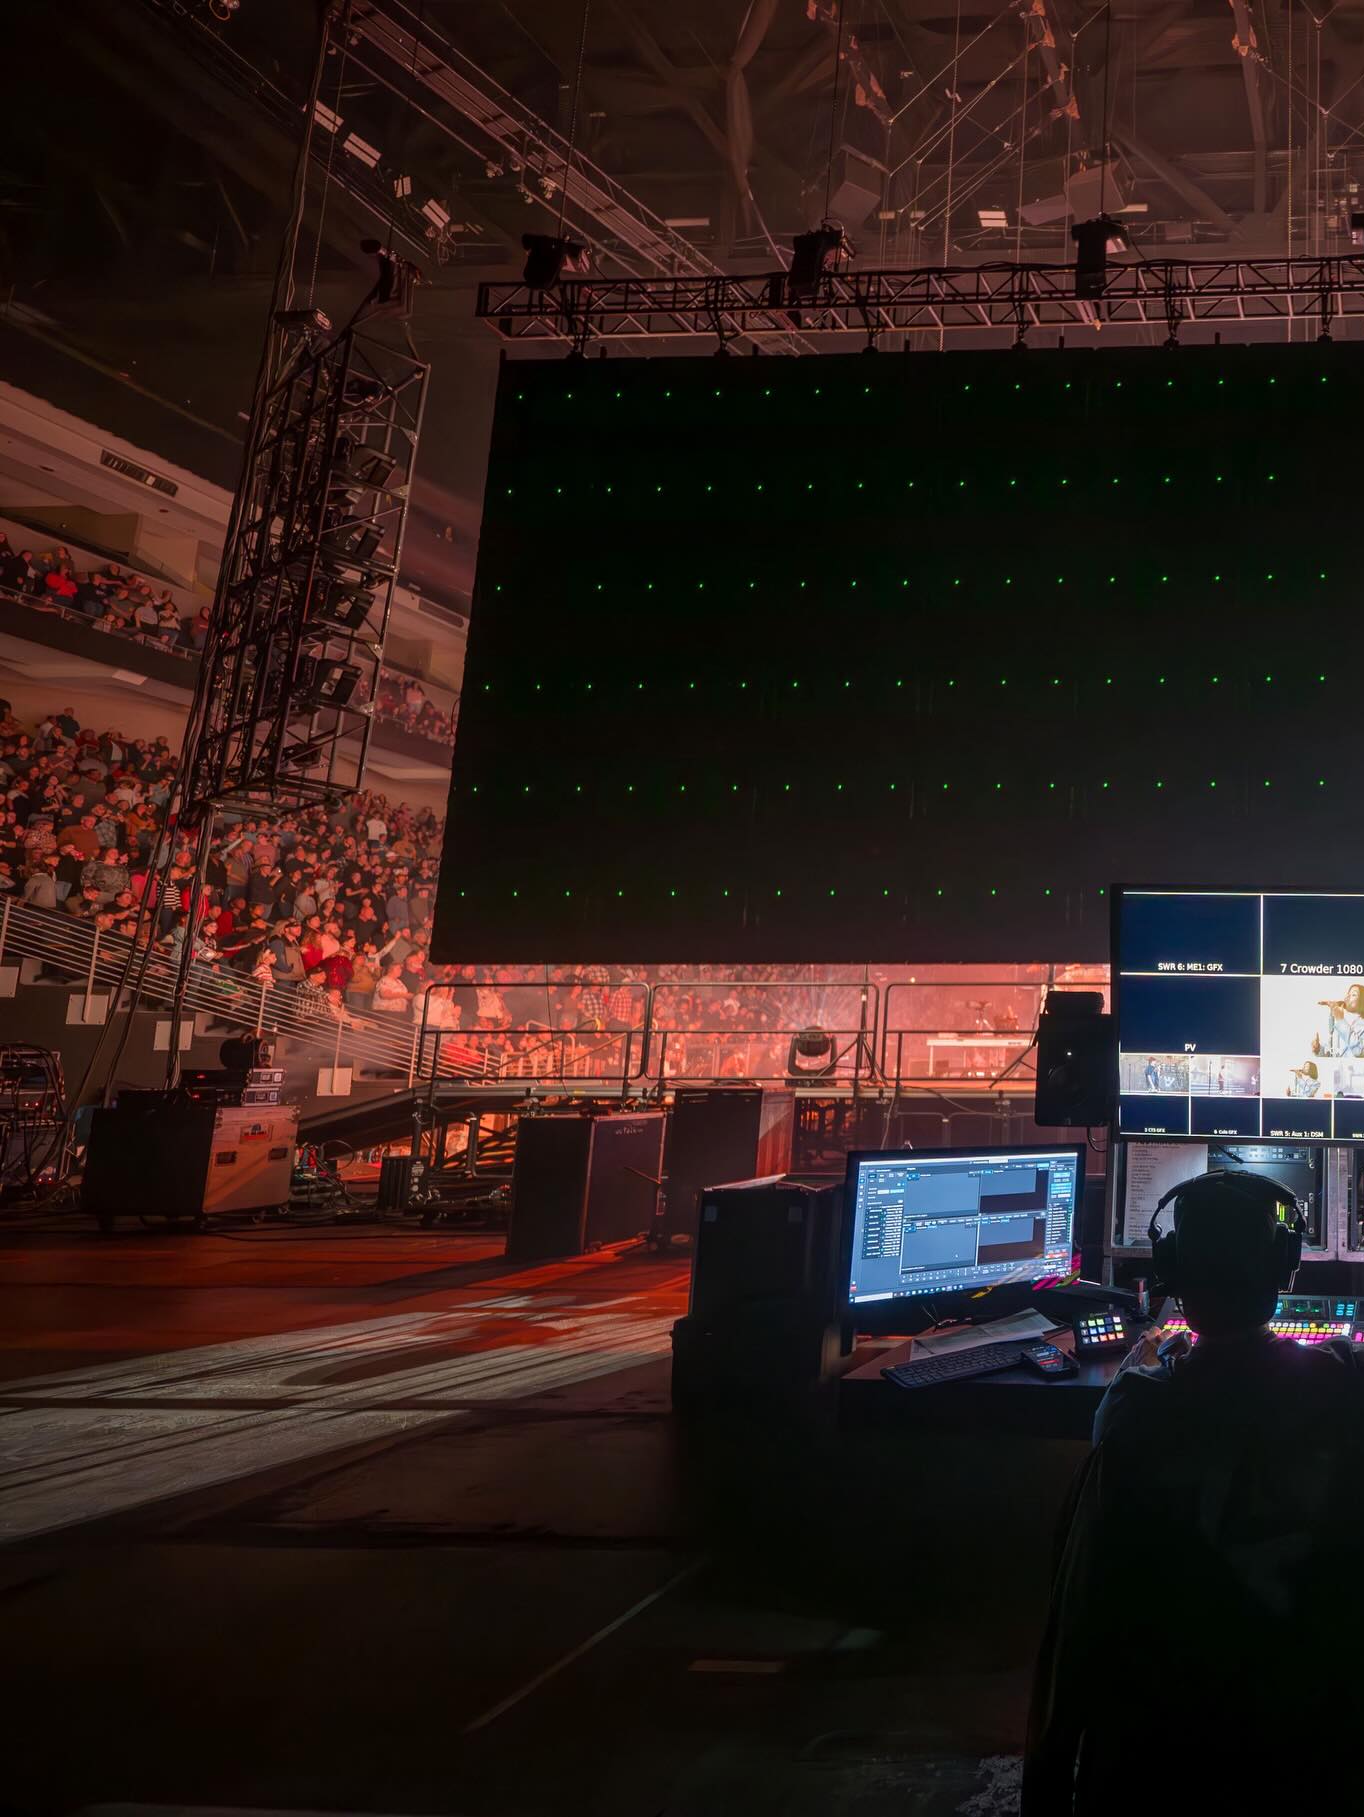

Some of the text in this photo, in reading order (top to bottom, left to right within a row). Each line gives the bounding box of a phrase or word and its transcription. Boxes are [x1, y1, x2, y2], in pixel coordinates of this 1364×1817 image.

[1157, 962, 1223, 971] SWR 6: ME1: GFX
[1280, 963, 1287, 973] 7
[1290, 963, 1334, 974] Crowder
[1336, 964, 1363, 975] 1080
[1184, 1043, 1196, 1052] PV
